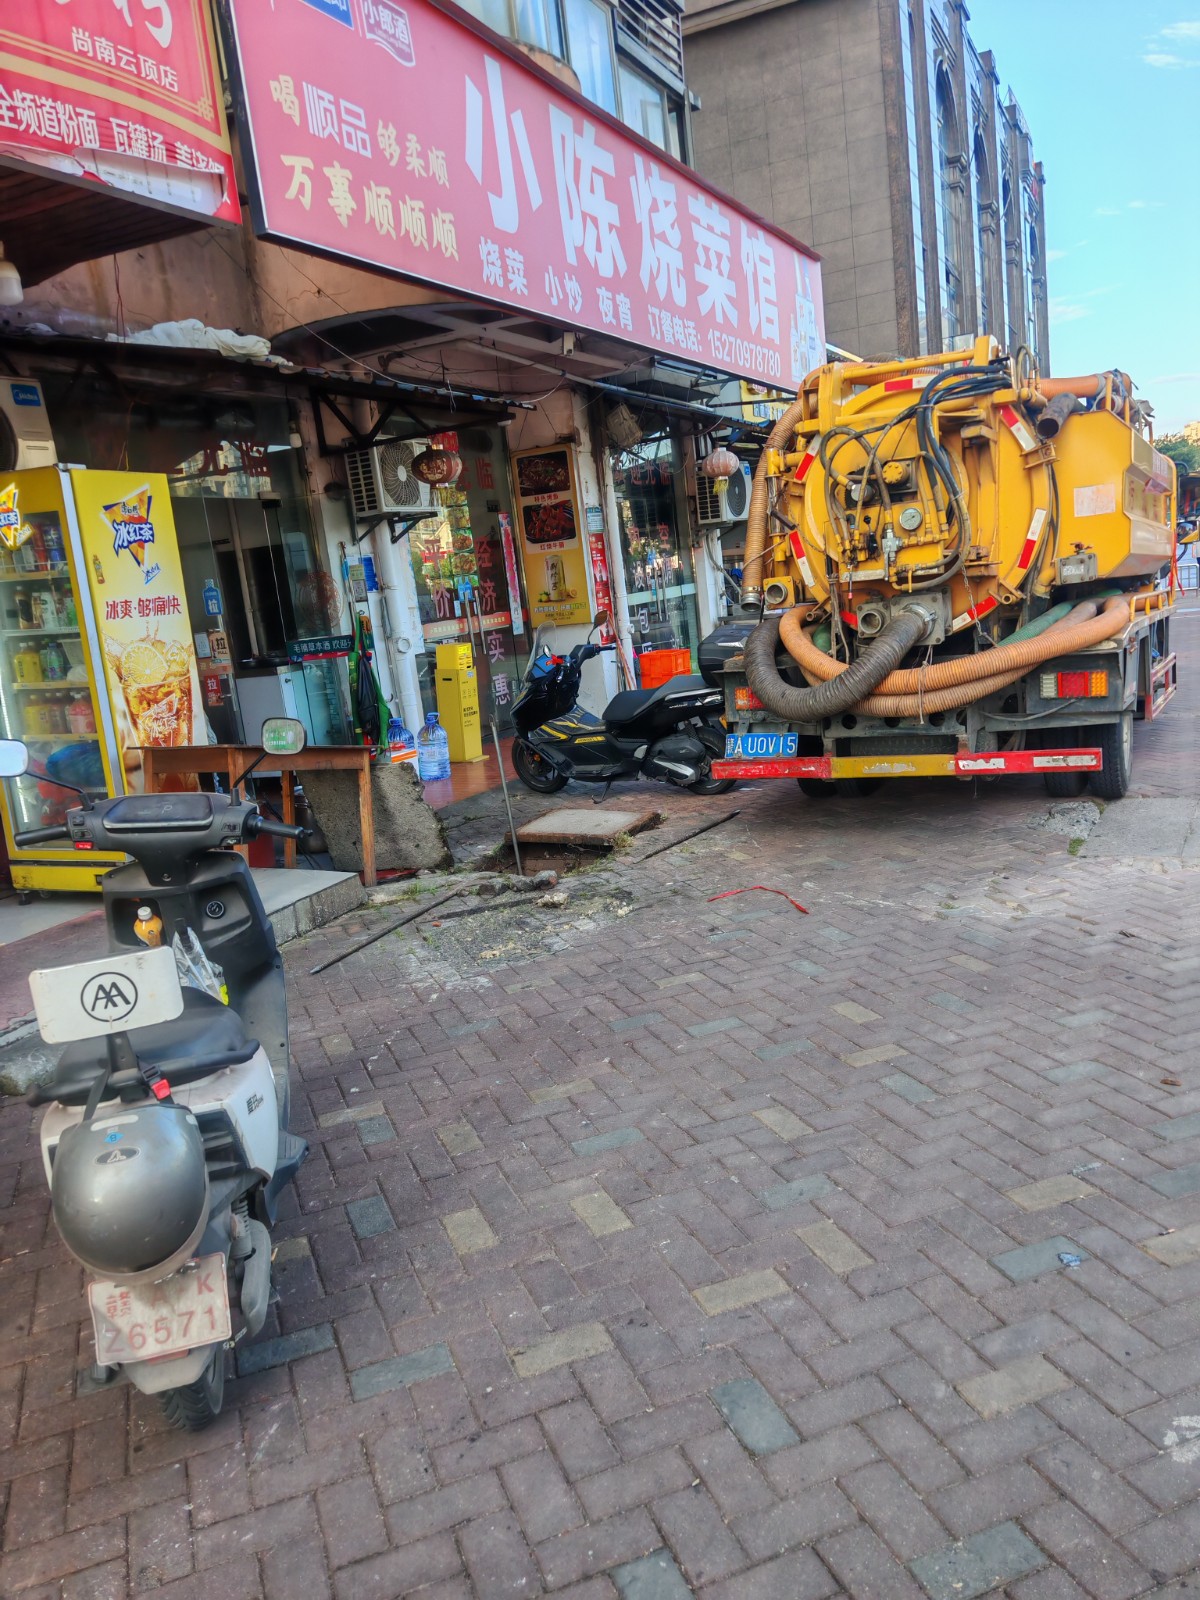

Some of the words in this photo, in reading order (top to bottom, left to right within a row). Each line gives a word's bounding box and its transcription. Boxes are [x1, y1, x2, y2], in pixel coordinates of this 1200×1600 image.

[364, 0, 409, 45] 小郎酒
[72, 26, 179, 93] 尚南云顶店
[109, 117, 168, 165] 瓦罐汤
[280, 154, 460, 262] 万事顺顺顺
[465, 54, 780, 345] 小陈烧菜馆
[479, 235, 529, 296] 烧菜
[544, 265, 583, 315] 小炒
[596, 285, 634, 332] 夜宵
[707, 328, 781, 378] 15270978780
[113, 520, 155, 552] 冰红茶
[208, 599, 219, 613] 拉
[473, 535, 512, 706] 经济实惠
[215, 637, 227, 650] 拉
[207, 678, 218, 691] 拉
[104, 1306, 218, 1355] Z6571
